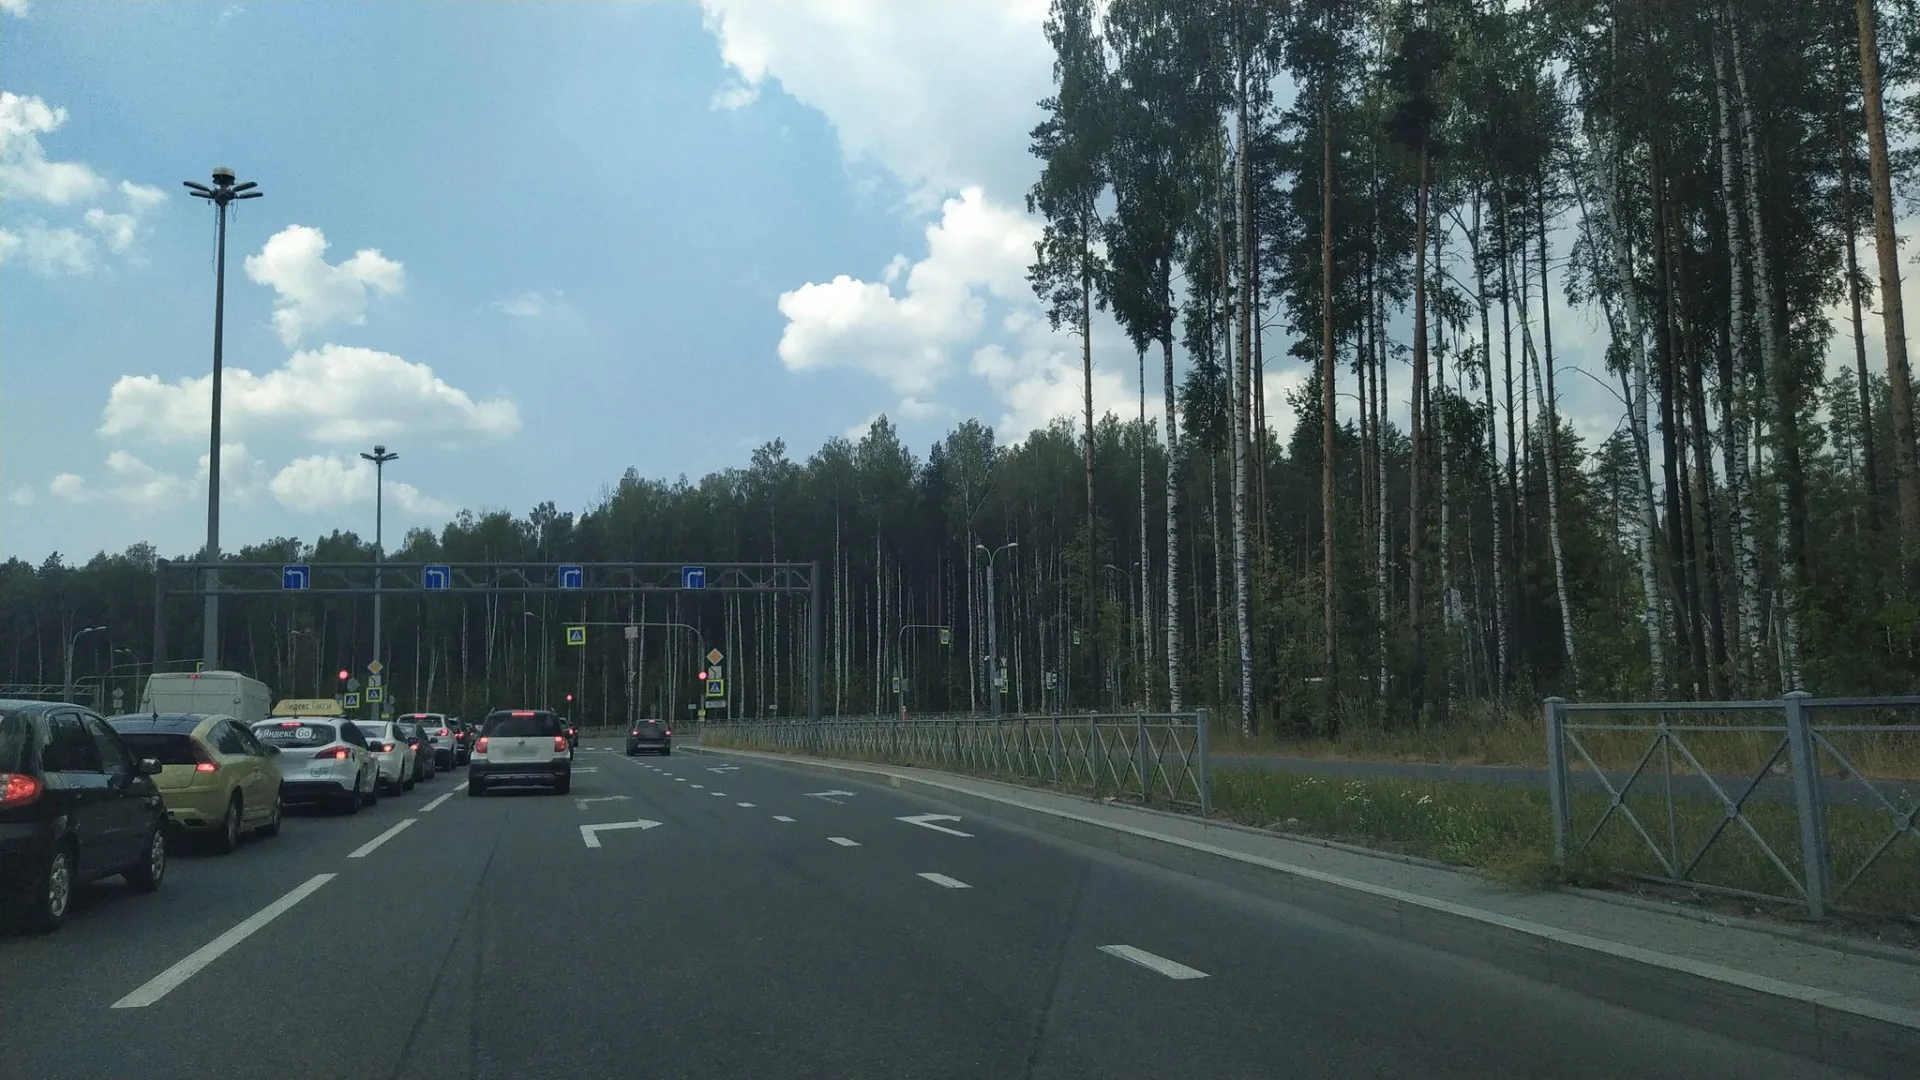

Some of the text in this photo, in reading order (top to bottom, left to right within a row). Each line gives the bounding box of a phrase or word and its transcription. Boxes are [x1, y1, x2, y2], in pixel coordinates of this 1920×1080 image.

[284, 702, 332, 711] Яндекс Такси
[263, 729, 311, 738] Яндекс Go
